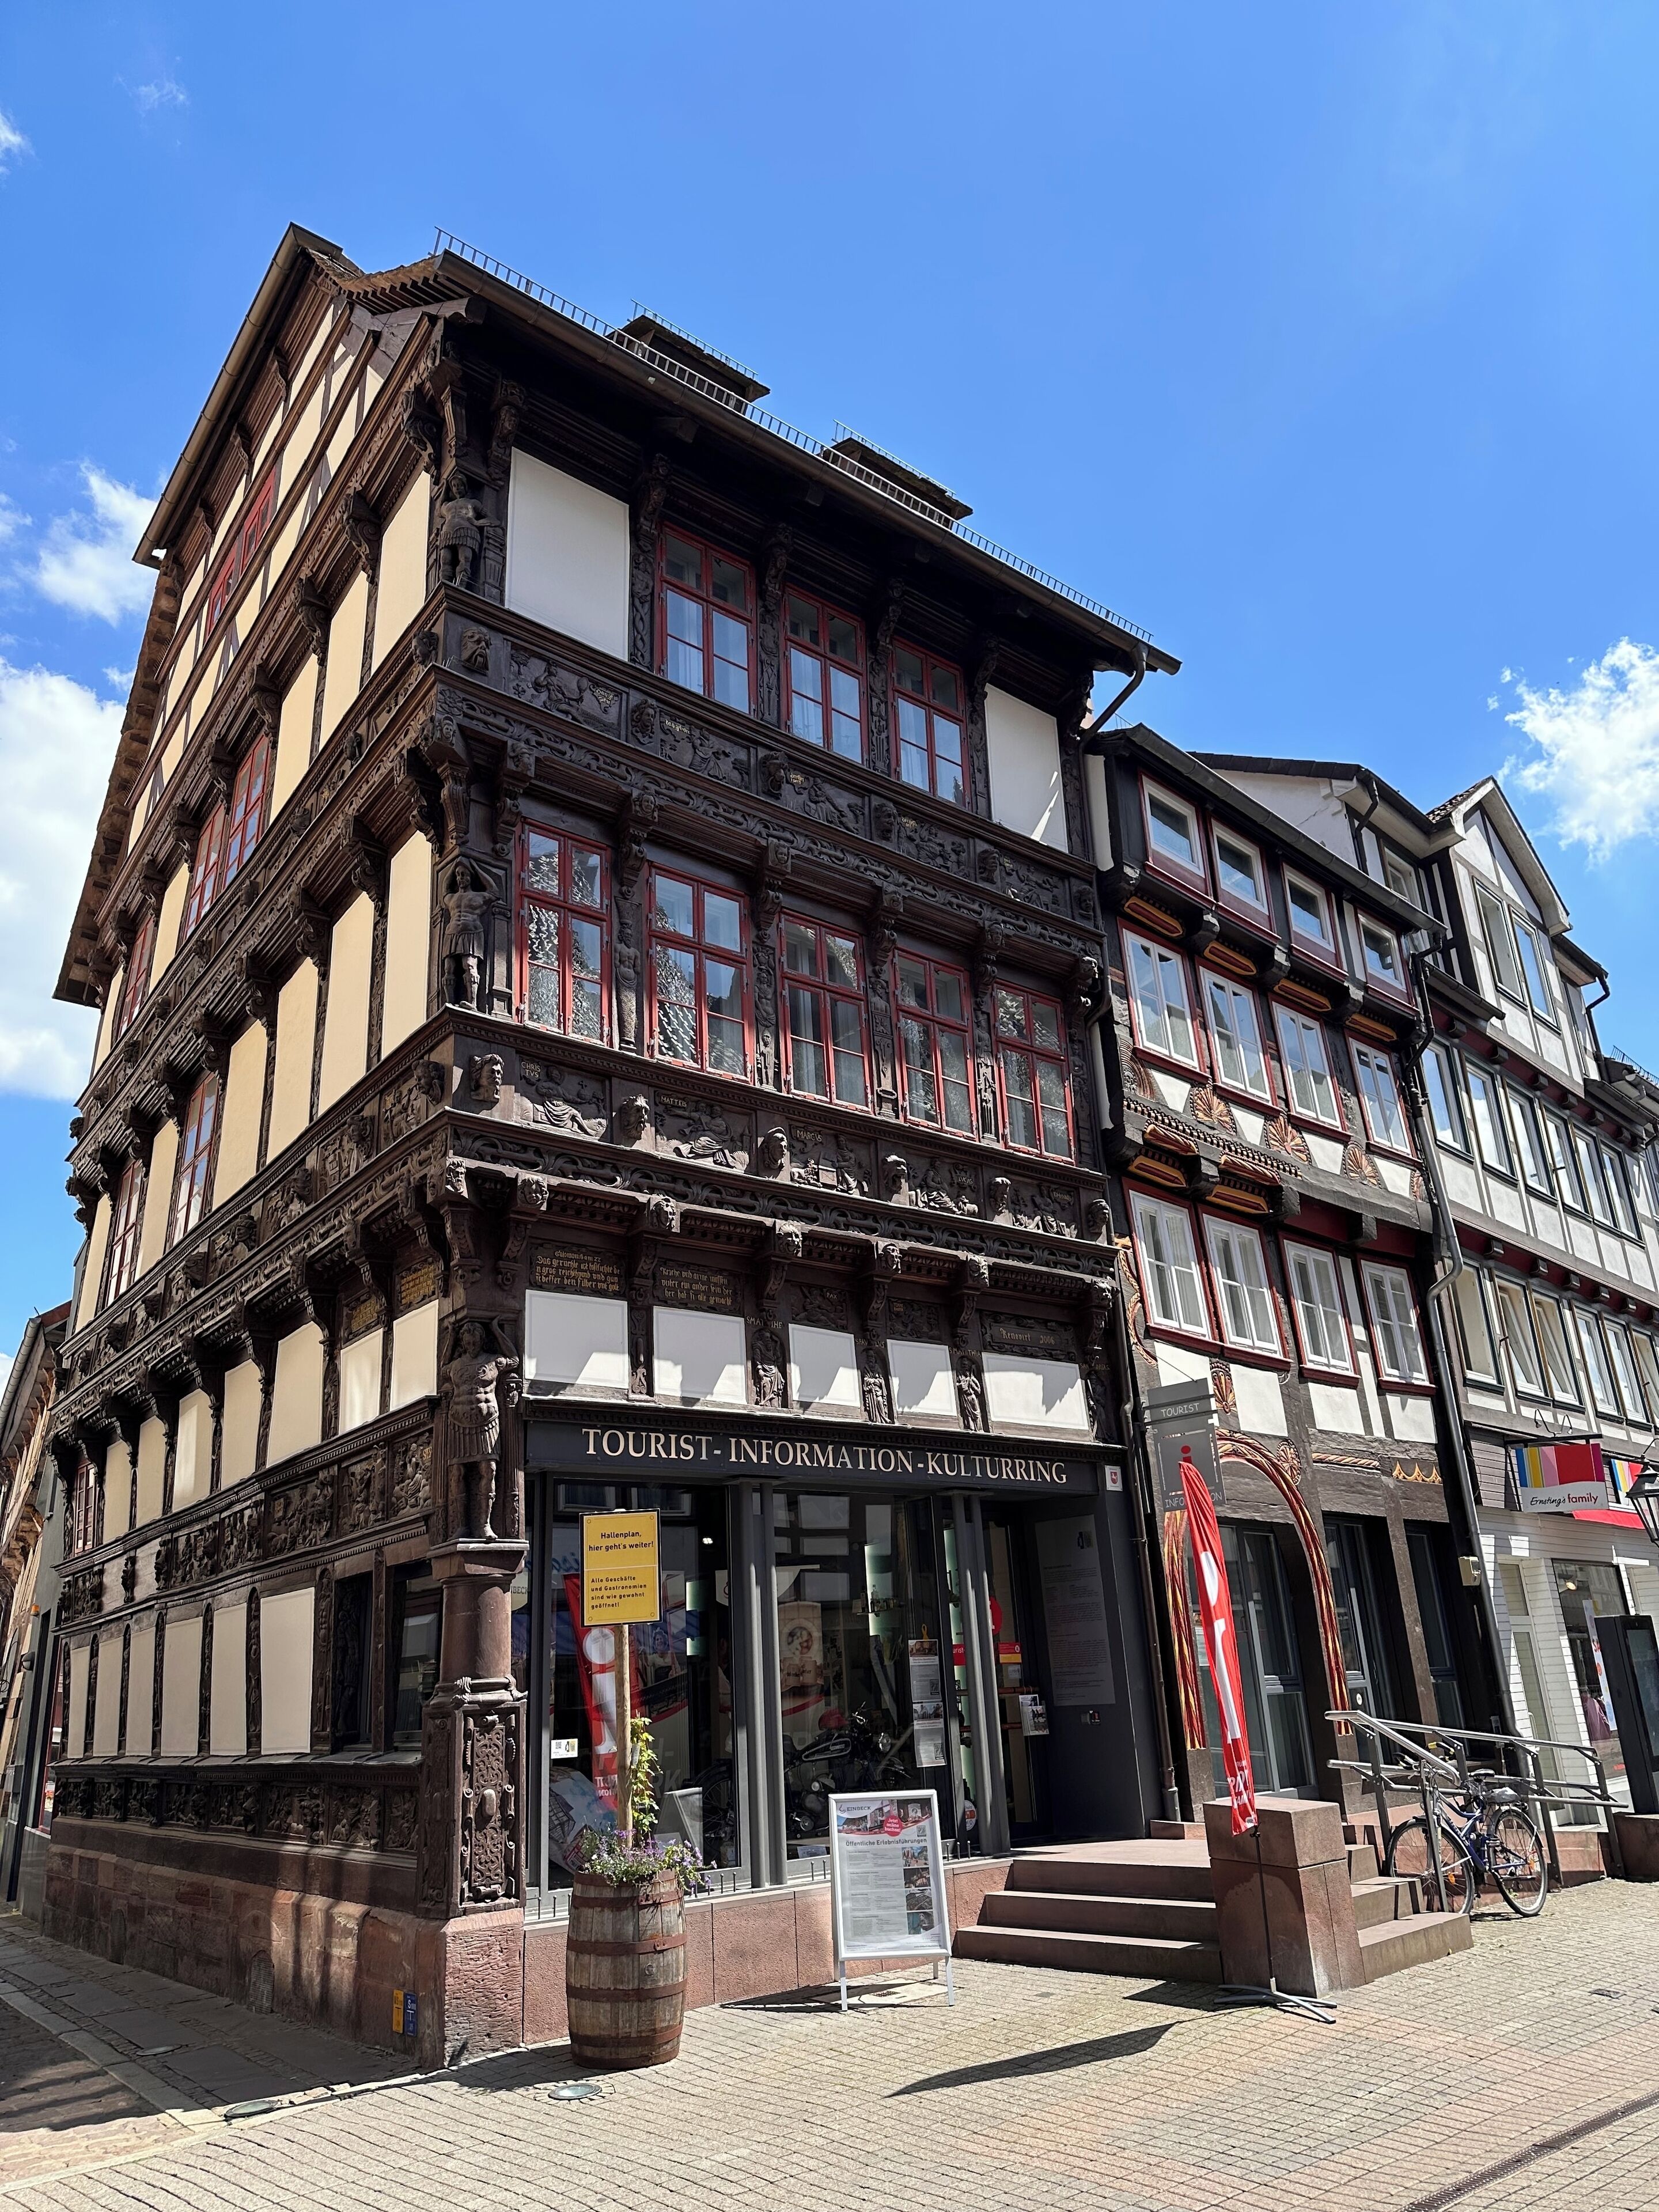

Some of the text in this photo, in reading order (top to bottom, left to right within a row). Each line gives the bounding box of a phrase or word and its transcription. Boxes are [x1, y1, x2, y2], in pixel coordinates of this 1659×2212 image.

[521, 1061, 541, 1073] CHRIS
[525, 1069, 540, 1078] TVS
[797, 1130, 822, 1142] MARCVS
[1161, 1403, 1199, 1417] TOURIST
[1531, 1493, 1599, 1508] Ernsting's family
[601, 1531, 642, 1540] Hallenplan,
[605, 1543, 627, 1552] geht's
[628, 1541, 654, 1549] weiter!
